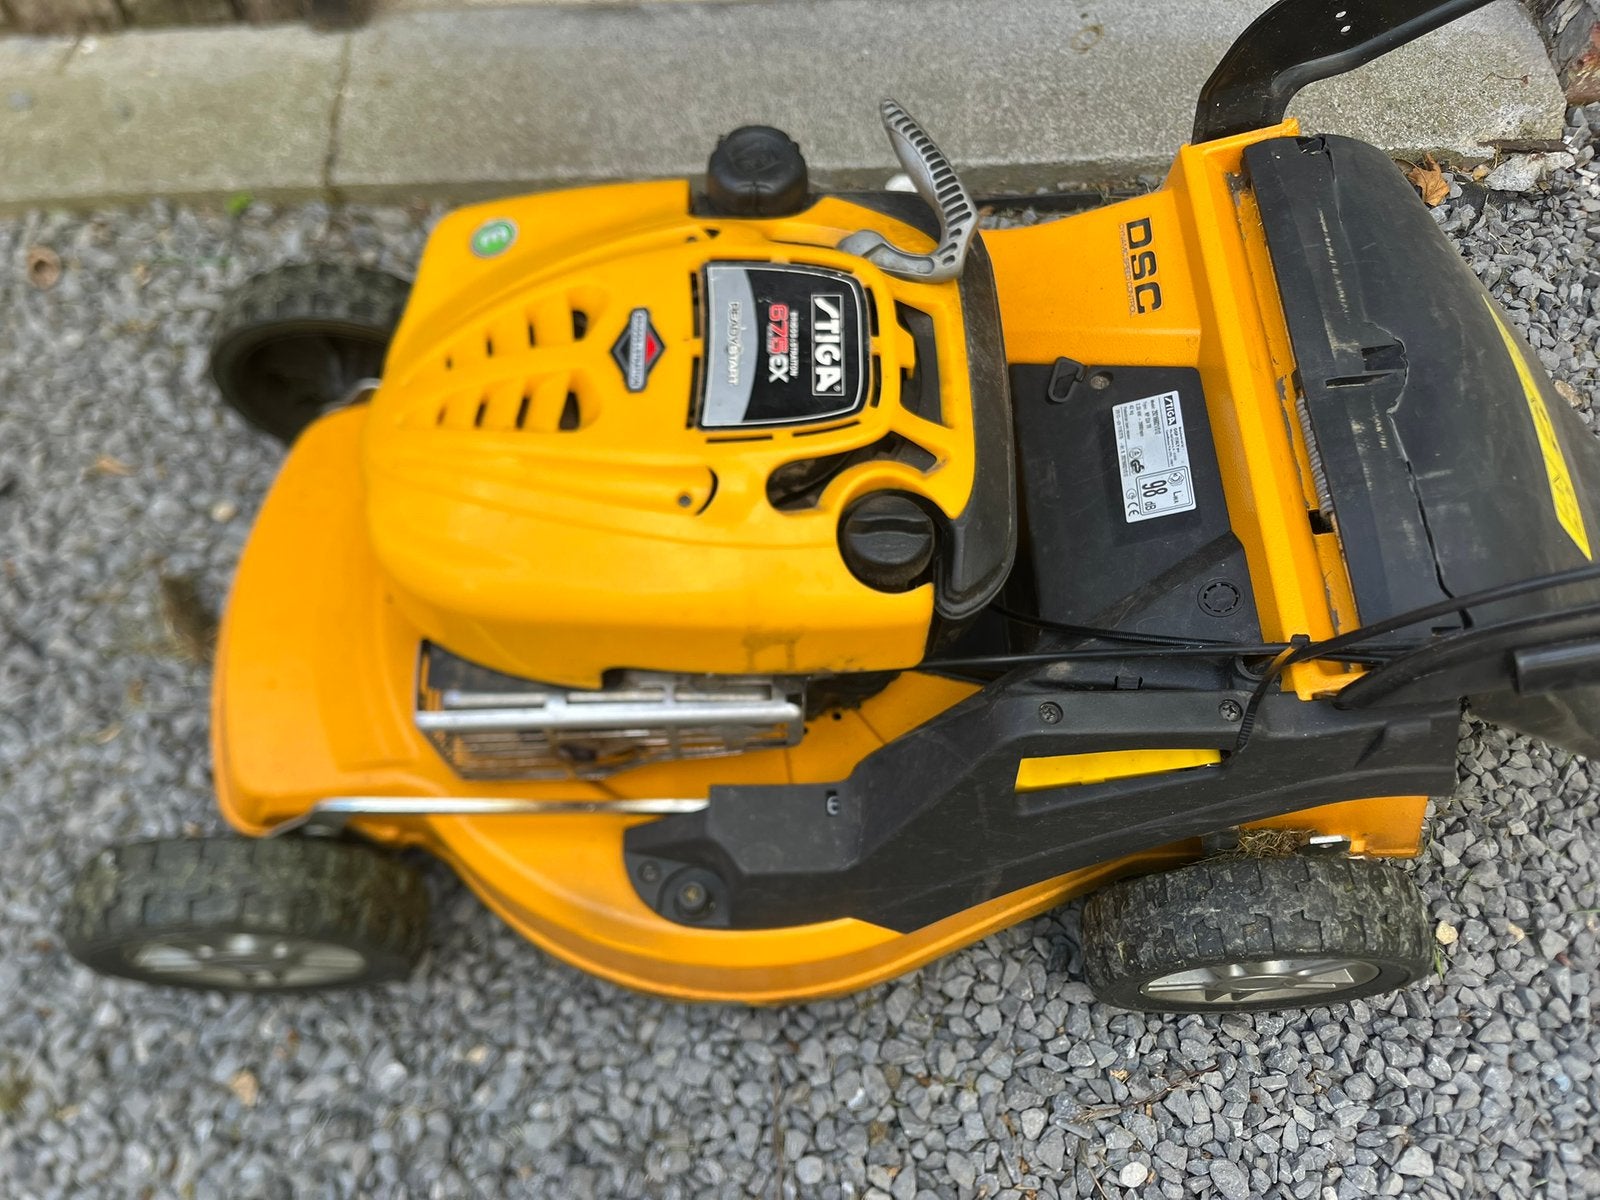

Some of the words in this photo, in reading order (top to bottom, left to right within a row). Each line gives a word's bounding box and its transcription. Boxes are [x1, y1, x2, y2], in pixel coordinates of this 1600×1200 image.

[1126, 217, 1162, 314] DSC
[814, 297, 841, 392] STIGA
[1164, 396, 1176, 425] STIGA
[1142, 480, 1168, 498] 98
[1145, 501, 1157, 511] dB
